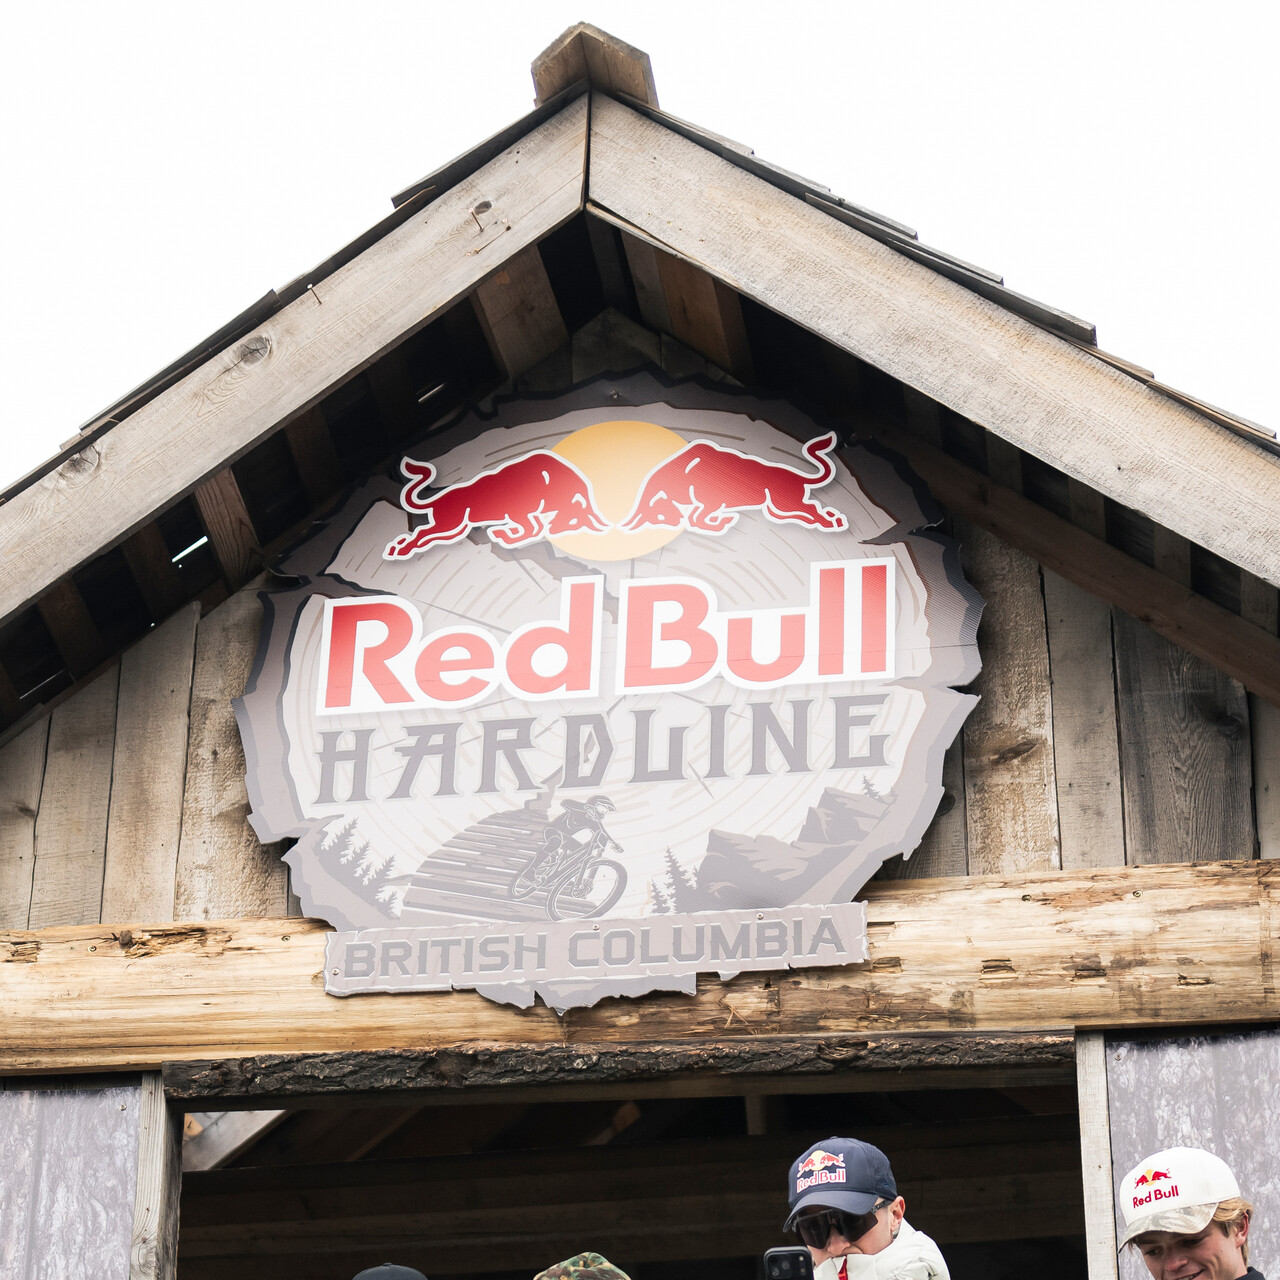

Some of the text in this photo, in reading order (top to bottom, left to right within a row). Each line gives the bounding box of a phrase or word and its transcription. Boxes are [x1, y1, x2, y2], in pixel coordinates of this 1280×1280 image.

[324, 564, 888, 709] Red Bull
[312, 692, 891, 804] HARDLINE
[342, 915, 848, 980] BRITISH COLUMBIA
[797, 1168, 846, 1193] Red Bull
[1132, 1185, 1179, 1209] Red Bull
